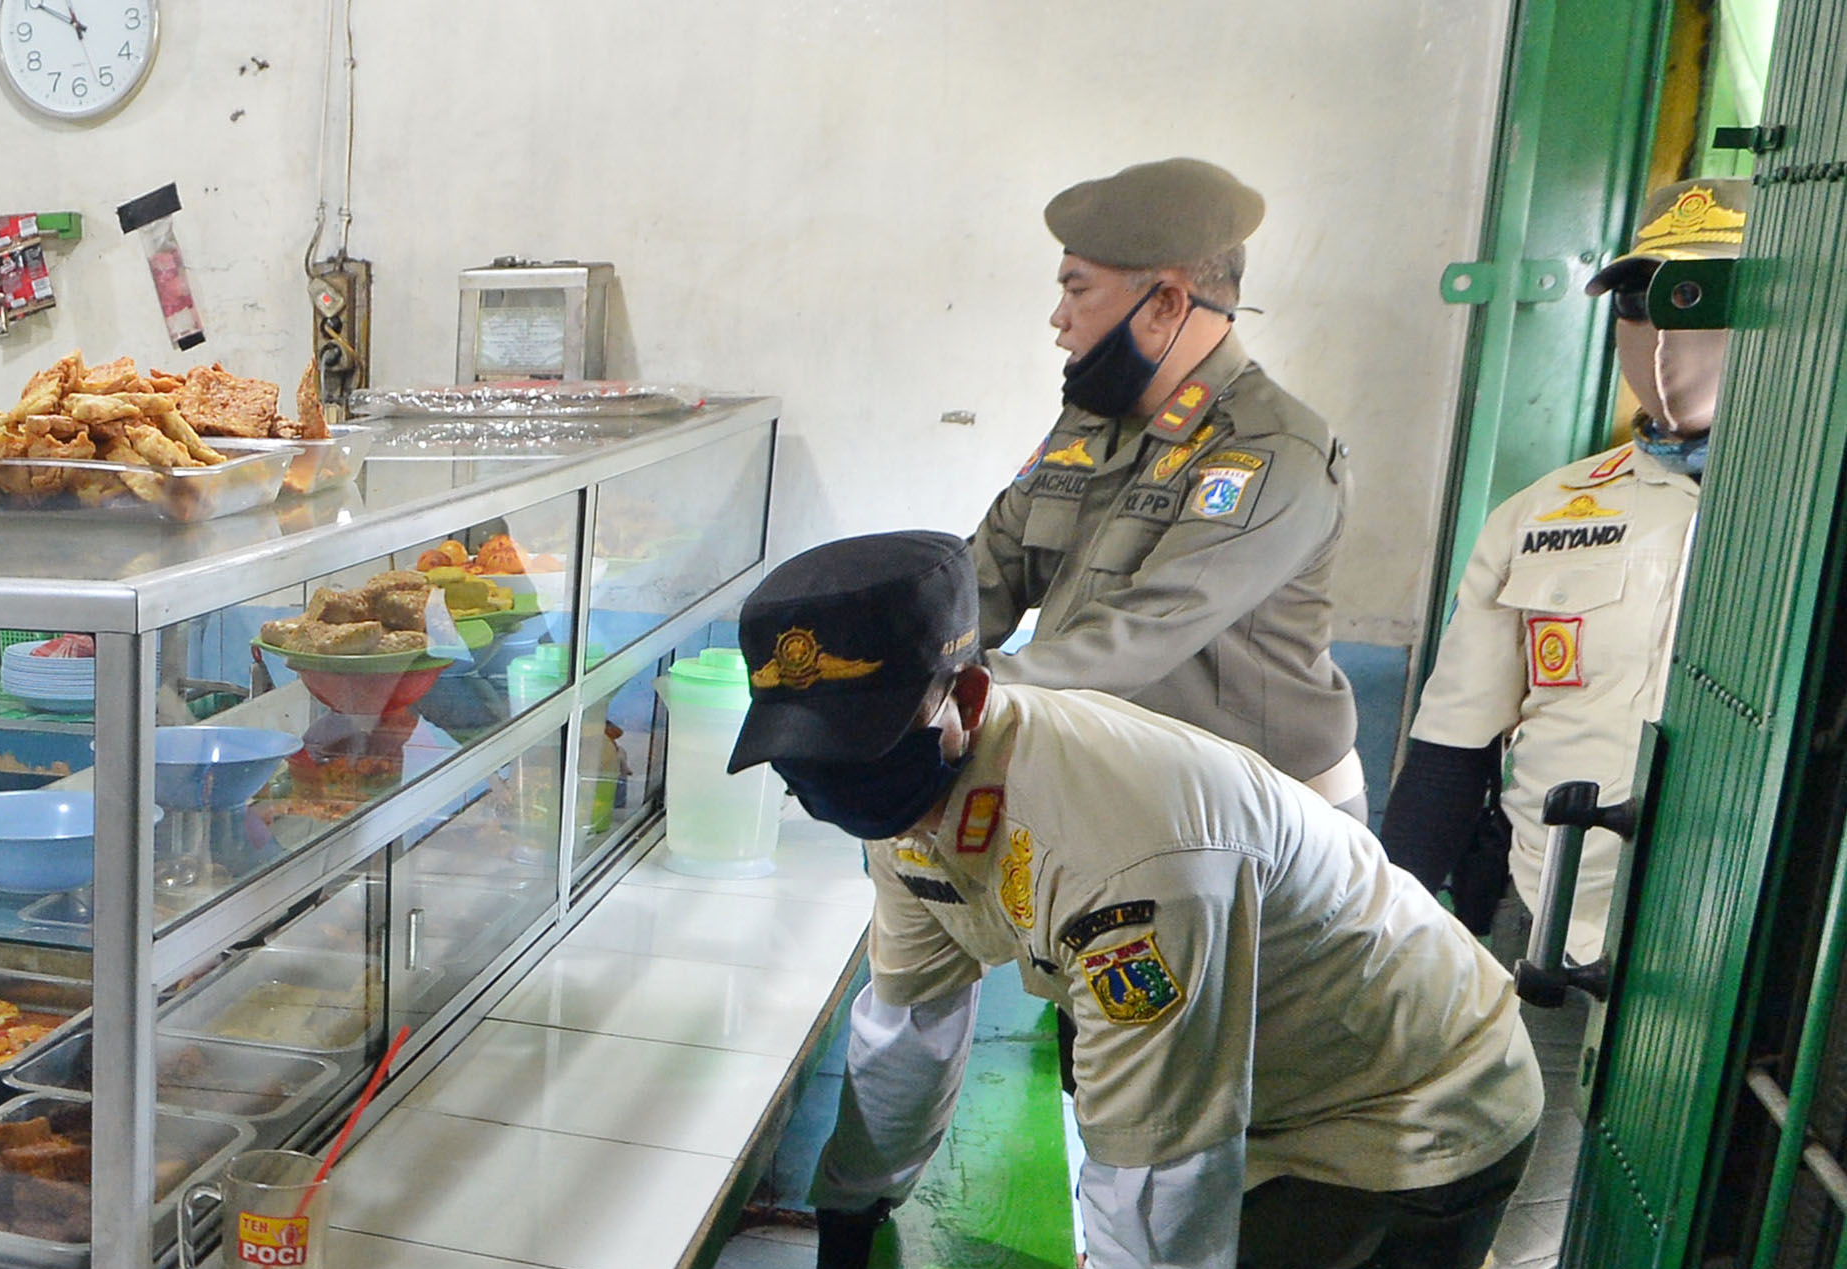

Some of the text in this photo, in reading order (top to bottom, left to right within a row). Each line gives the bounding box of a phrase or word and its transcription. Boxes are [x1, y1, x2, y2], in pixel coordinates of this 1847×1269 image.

[124, 7, 141, 30] 3
[16, 22, 33, 43] 9
[27, 50, 42, 72] 8
[117, 40, 133, 61] 4
[47, 71, 62, 93] 7
[98, 66, 114, 87] 5
[71, 77, 88, 98] 6
[243, 1217, 269, 1234] TEH
[243, 1242, 303, 1265] POCI
